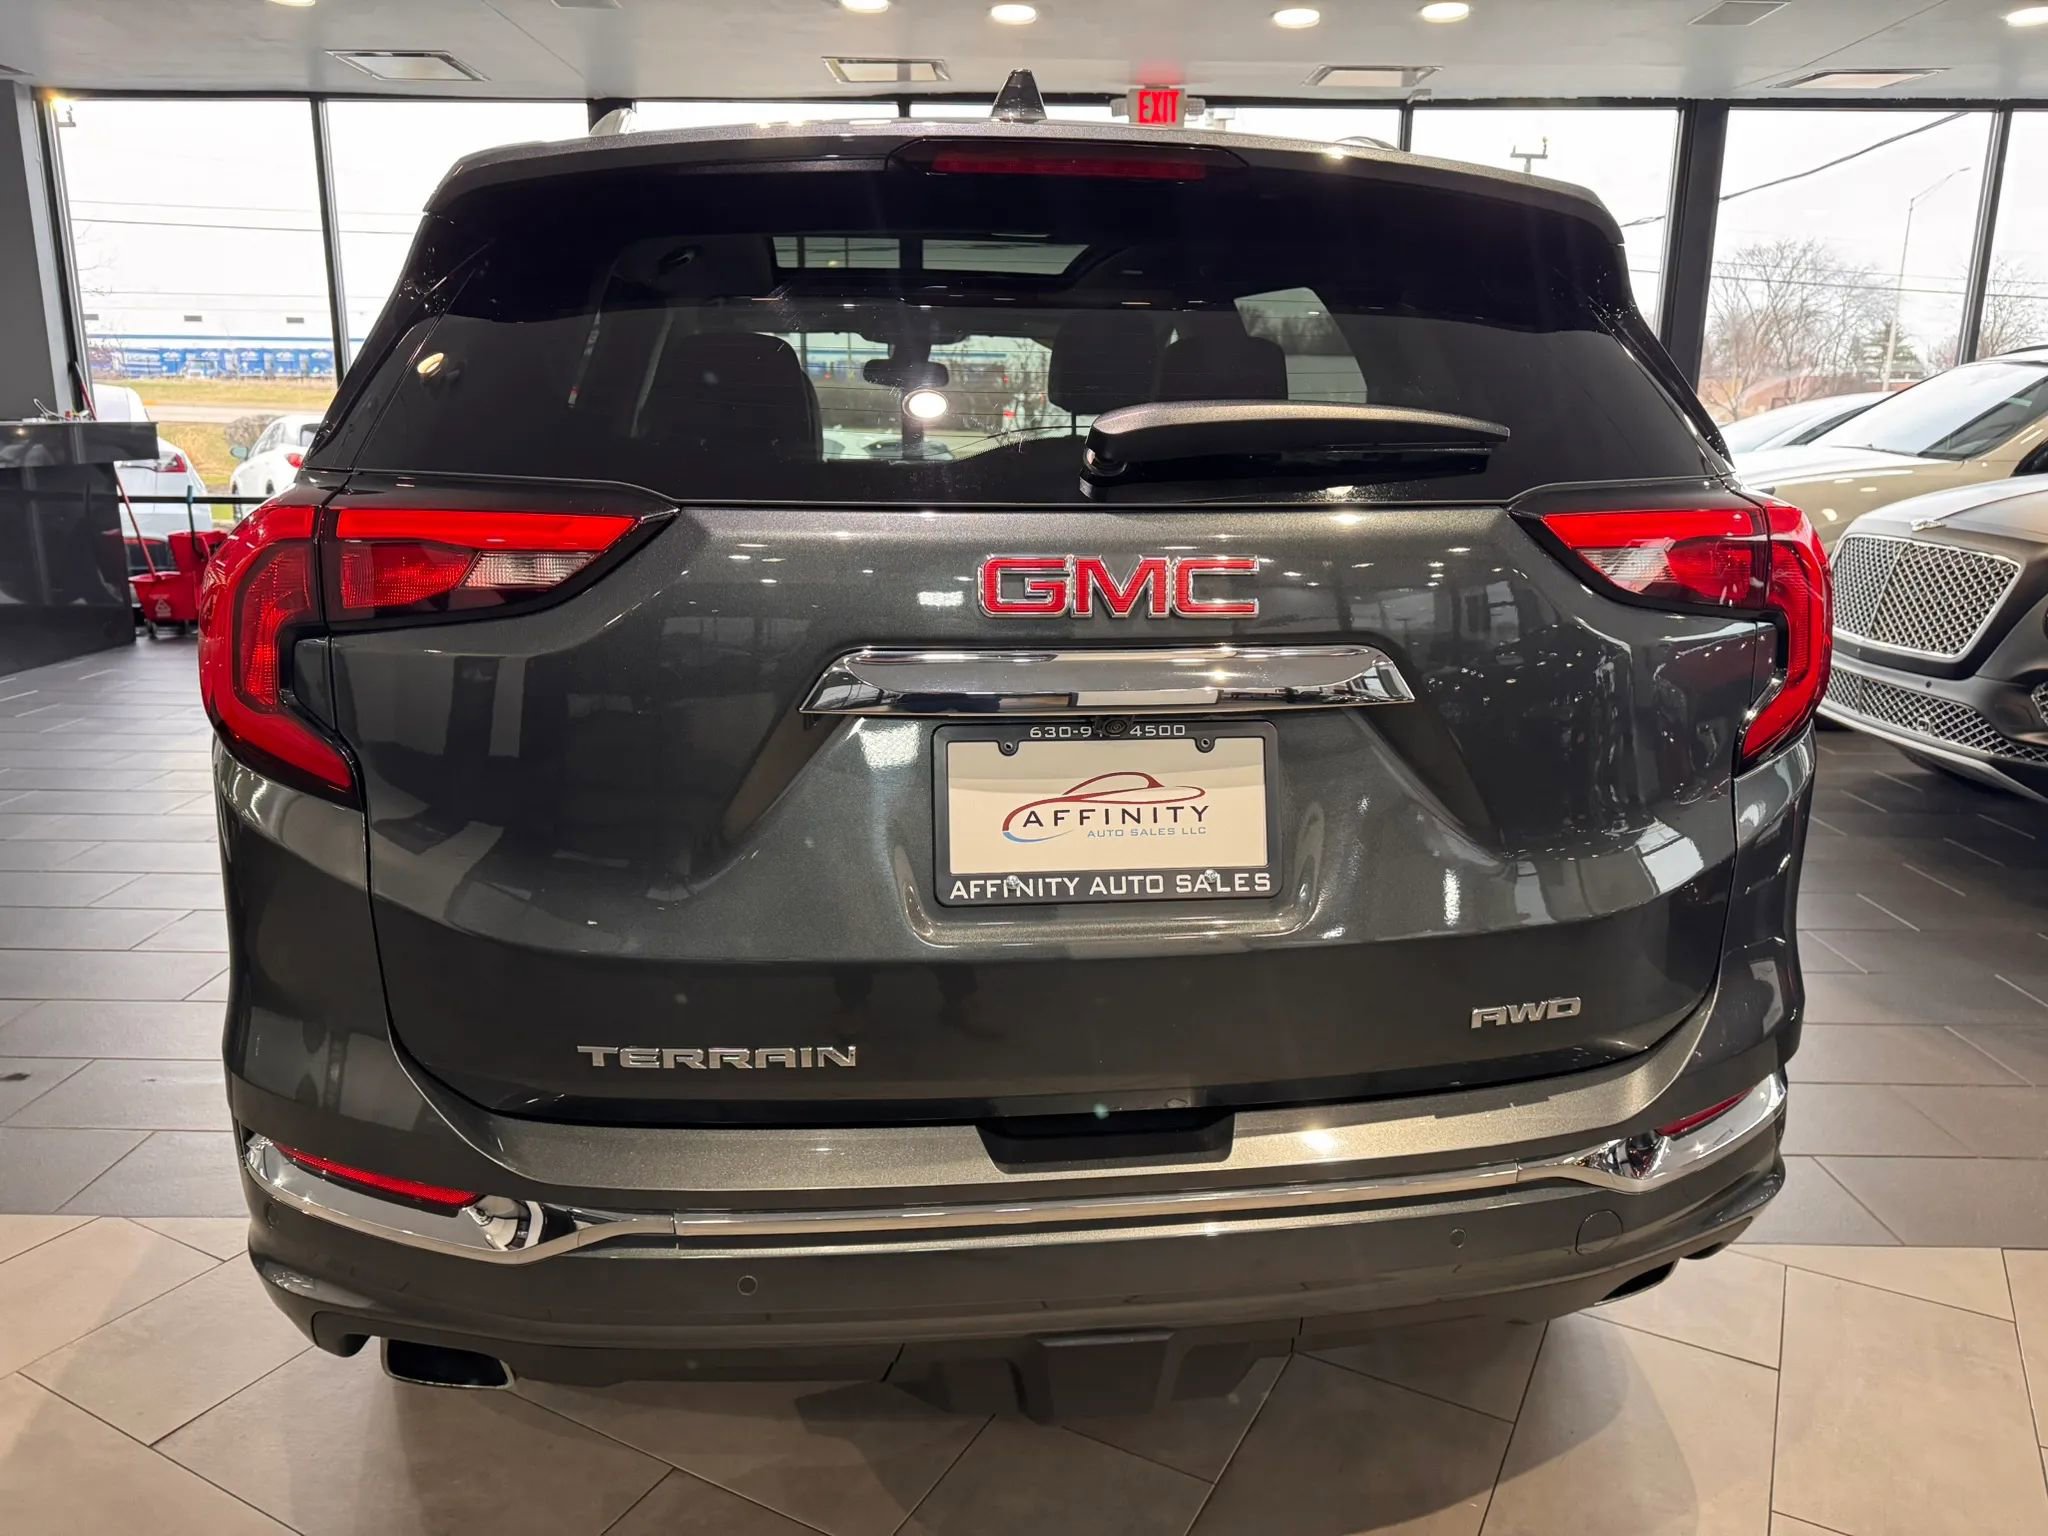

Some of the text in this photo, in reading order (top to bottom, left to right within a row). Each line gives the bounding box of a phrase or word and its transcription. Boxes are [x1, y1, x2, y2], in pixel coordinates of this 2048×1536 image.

[1138, 91, 1179, 124] EXIT
[977, 554, 1259, 618] GMC
[1022, 805, 1209, 828] AFFINITY
[1087, 826, 1207, 838] AUTO SALES LLC
[949, 872, 1271, 900] AFFINITY AUTO SALES
[1471, 996, 1582, 1029] AWD
[576, 1045, 857, 1069] TERRAIN
